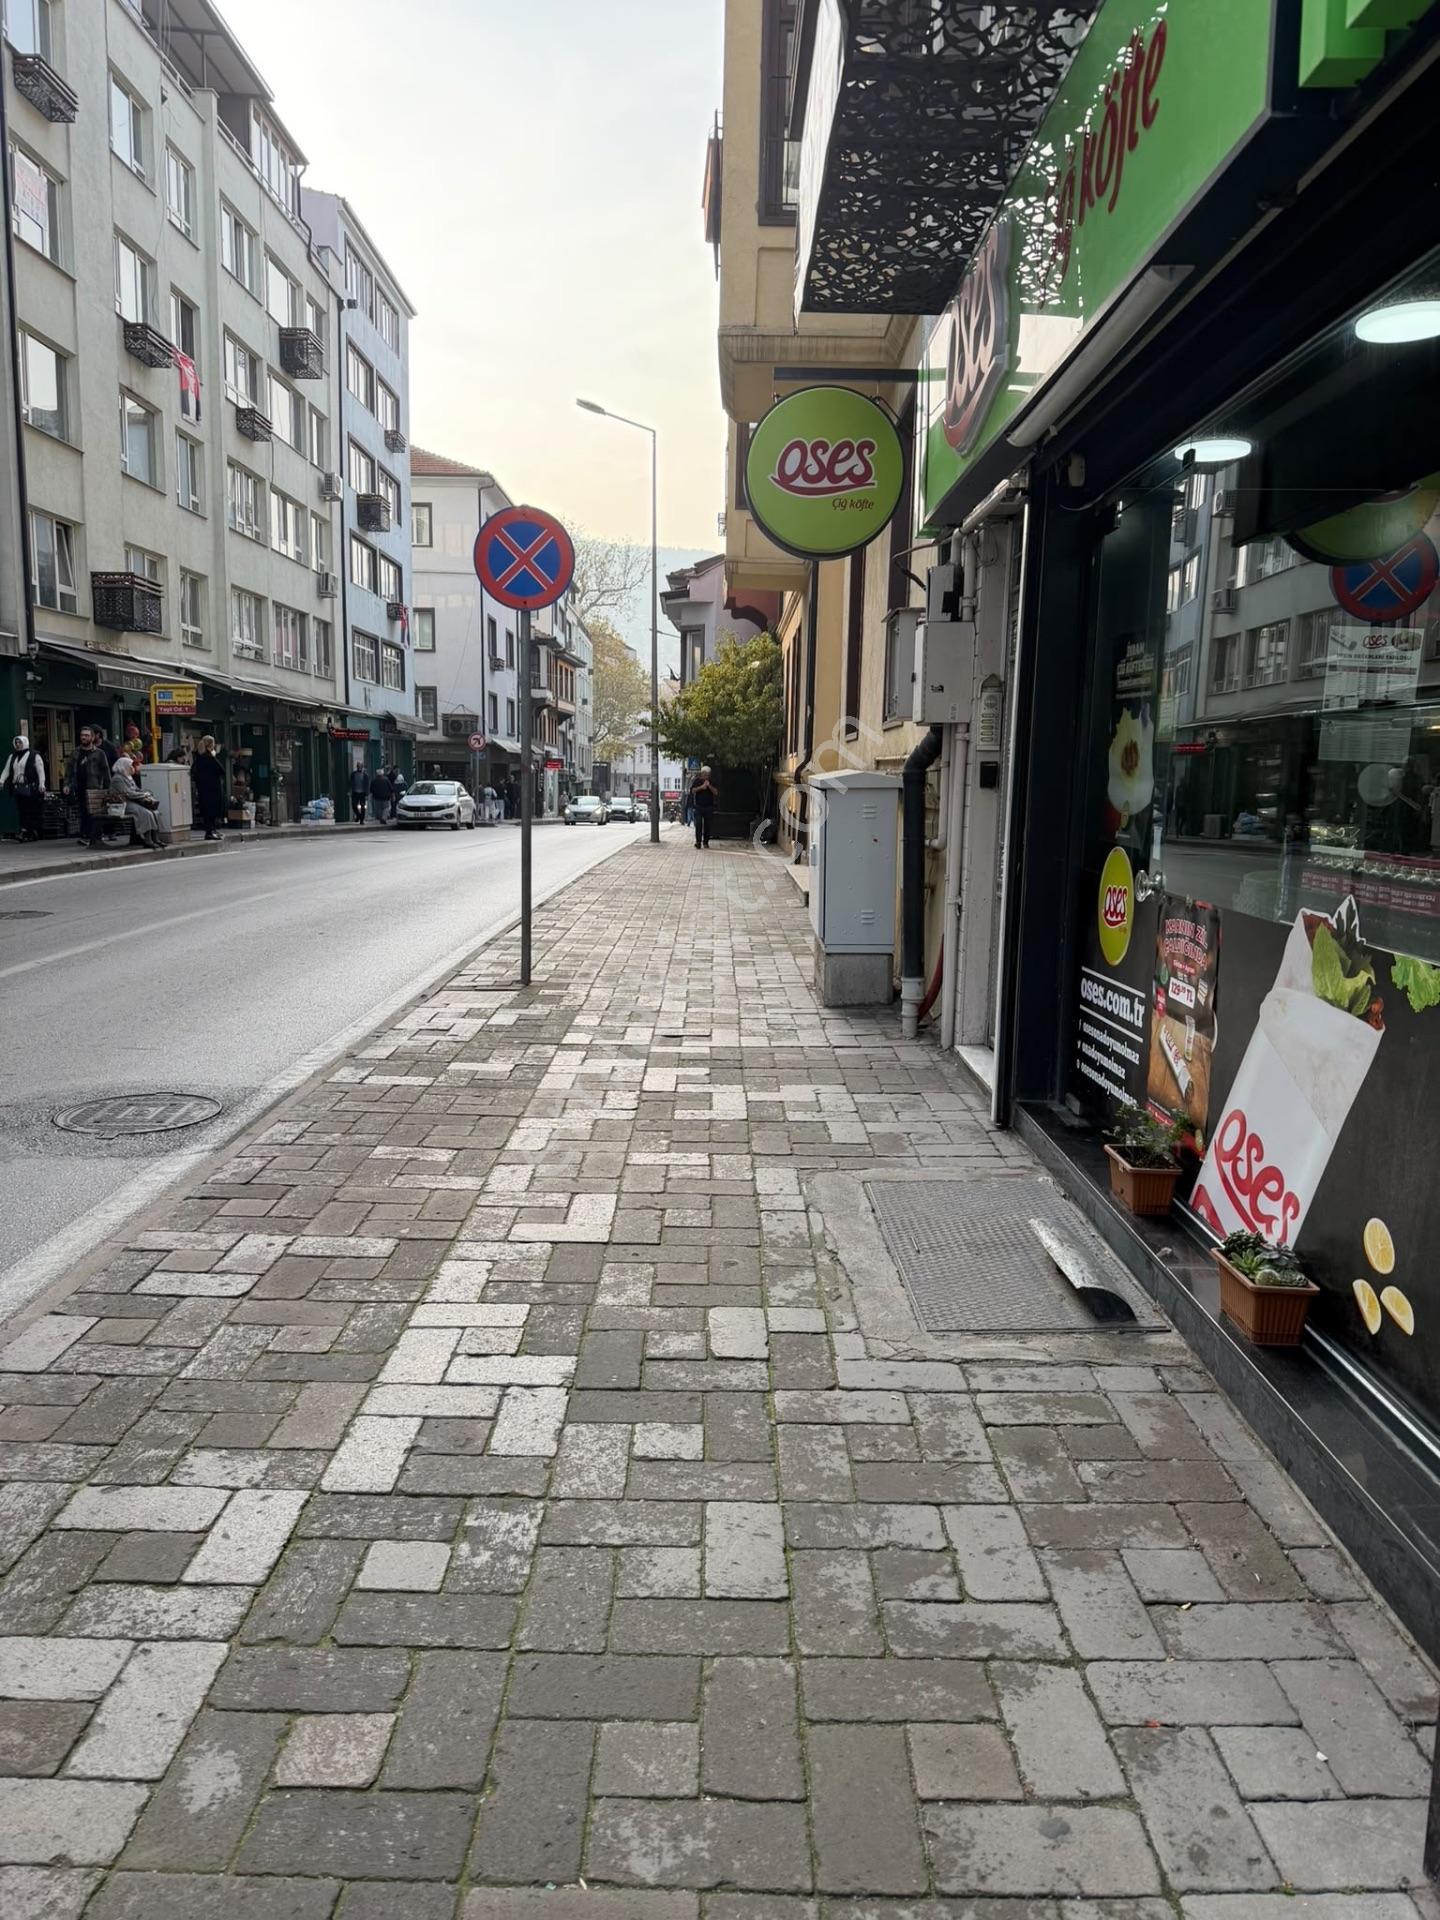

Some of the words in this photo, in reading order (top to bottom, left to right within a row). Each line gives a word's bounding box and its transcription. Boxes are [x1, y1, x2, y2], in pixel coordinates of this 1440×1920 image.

[1077, 19, 1167, 226] köfte
[773, 438, 877, 490] oses
[832, 498, 848, 511] Çiğ
[849, 499, 874, 512] köfte
[1103, 886, 1127, 927] oses
[1080, 976, 1145, 1028] oses.com.tr
[1214, 1108, 1300, 1244] oses
